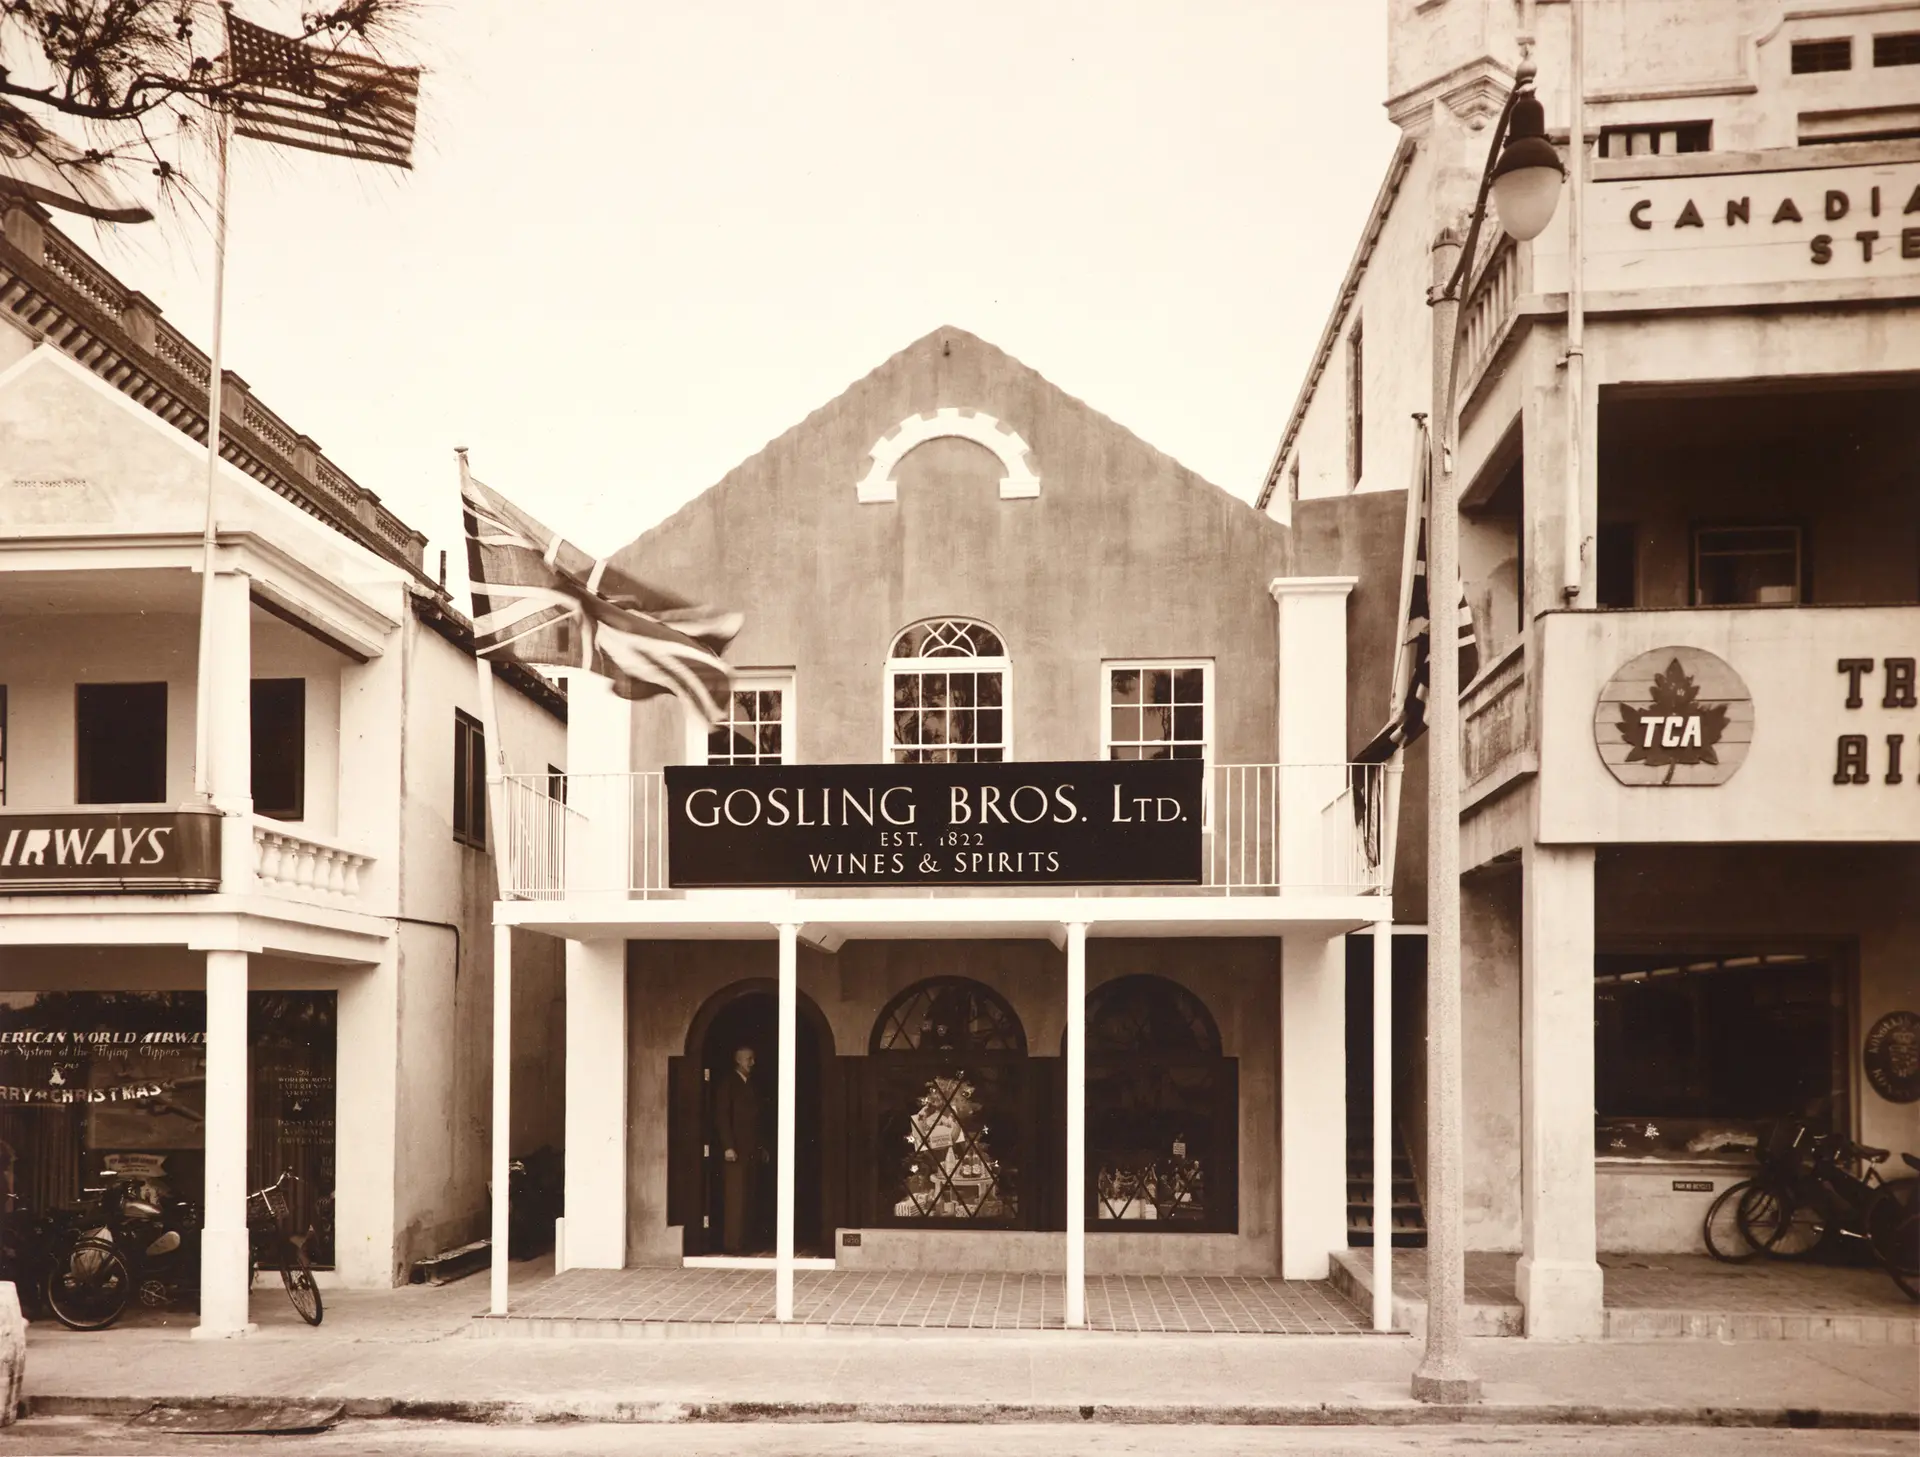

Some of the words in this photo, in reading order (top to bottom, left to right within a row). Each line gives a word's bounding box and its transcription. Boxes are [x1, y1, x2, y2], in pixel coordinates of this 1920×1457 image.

[1810, 227, 1920, 265] STE
[1837, 657, 1917, 709] TR
[1640, 716, 1701, 747] TCA
[1833, 734, 1920, 785] AI
[685, 786, 917, 827] GOSLING
[948, 784, 1088, 825] BROS.
[880, 831, 923, 847] EST.
[939, 831, 984, 847] 1822
[808, 852, 904, 874] WINES
[918, 852, 942, 874] &
[954, 851, 1060, 873] SPIRITS
[73, 1032, 137, 1043] WORLD
[17, 1044, 52, 1060] System
[93, 1044, 128, 1060] Flying
[140, 1044, 180, 1060] Clippers
[51, 1083, 162, 1104] CHRISTMAS
